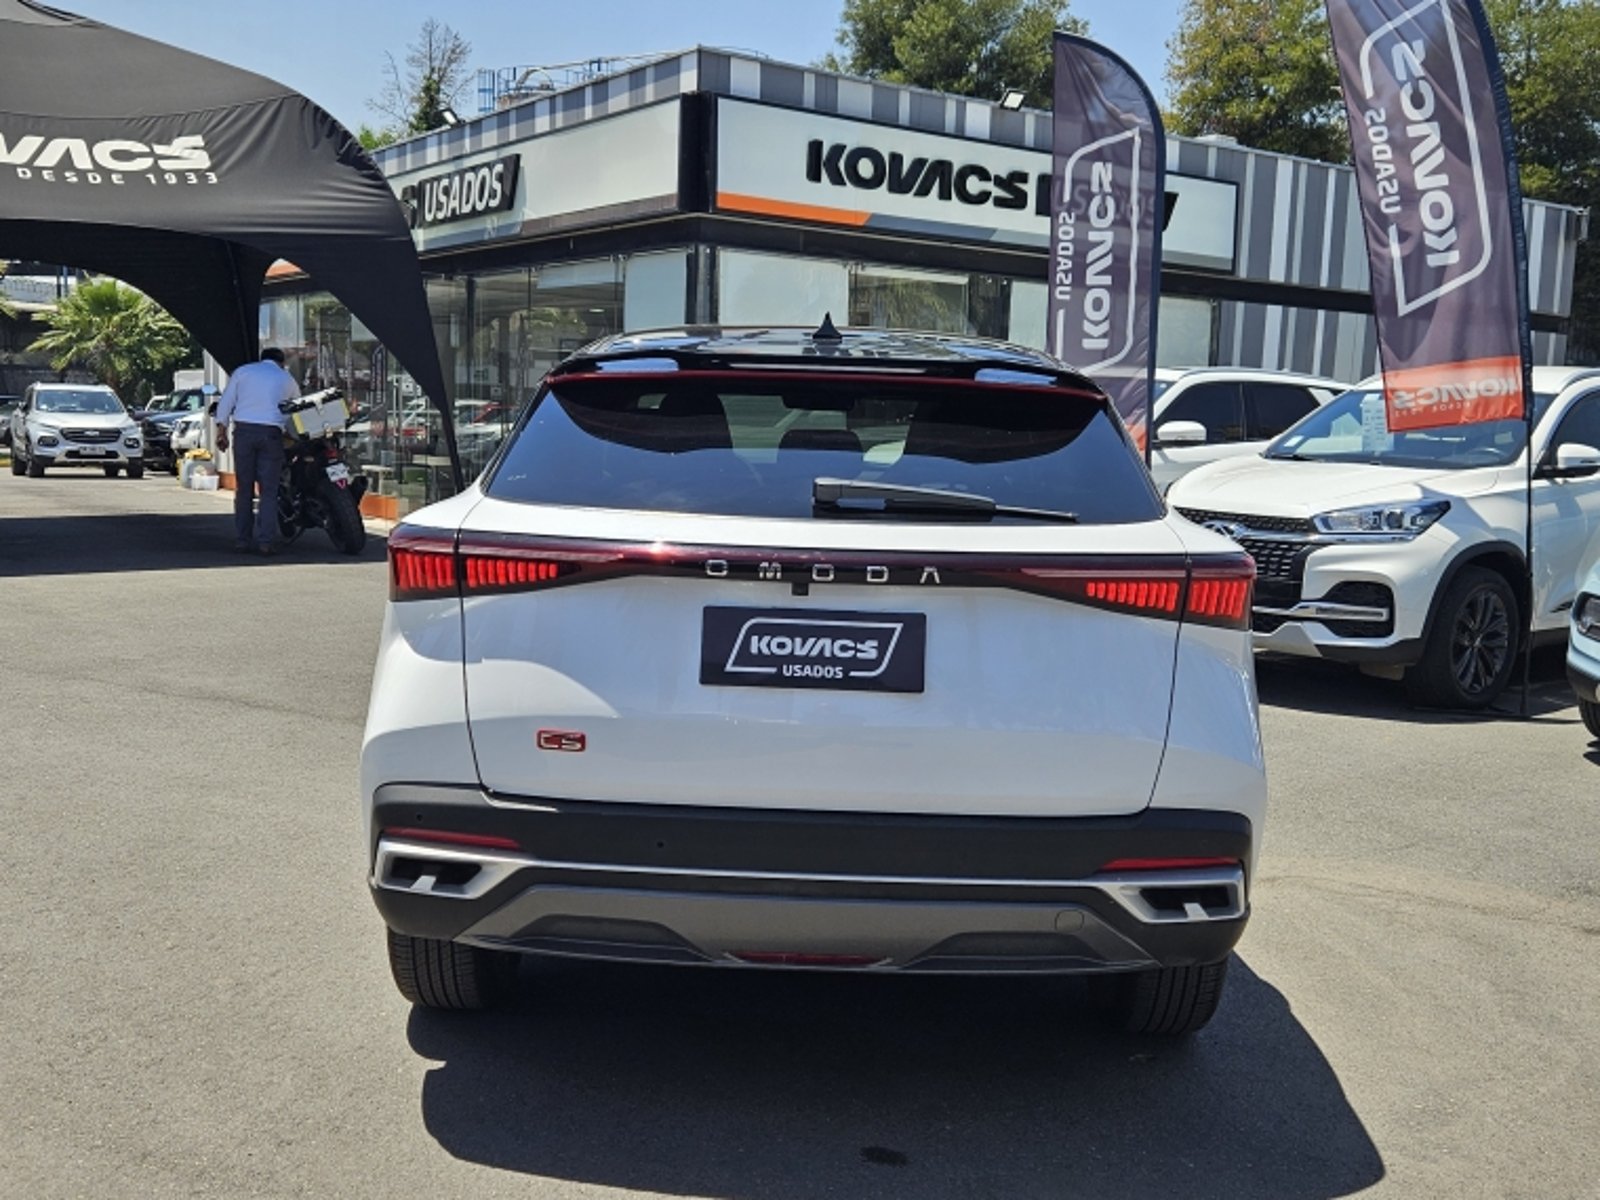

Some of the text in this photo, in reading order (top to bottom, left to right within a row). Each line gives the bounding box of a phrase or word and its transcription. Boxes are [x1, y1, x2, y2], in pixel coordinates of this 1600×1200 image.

[16, 167, 218, 184] DESDE 1933
[807, 138, 1028, 210] KOVACS
[424, 163, 504, 222] USADOS
[705, 559, 941, 584] OMODA
[750, 635, 879, 660] KOVACS
[782, 664, 843, 679] USADOS
